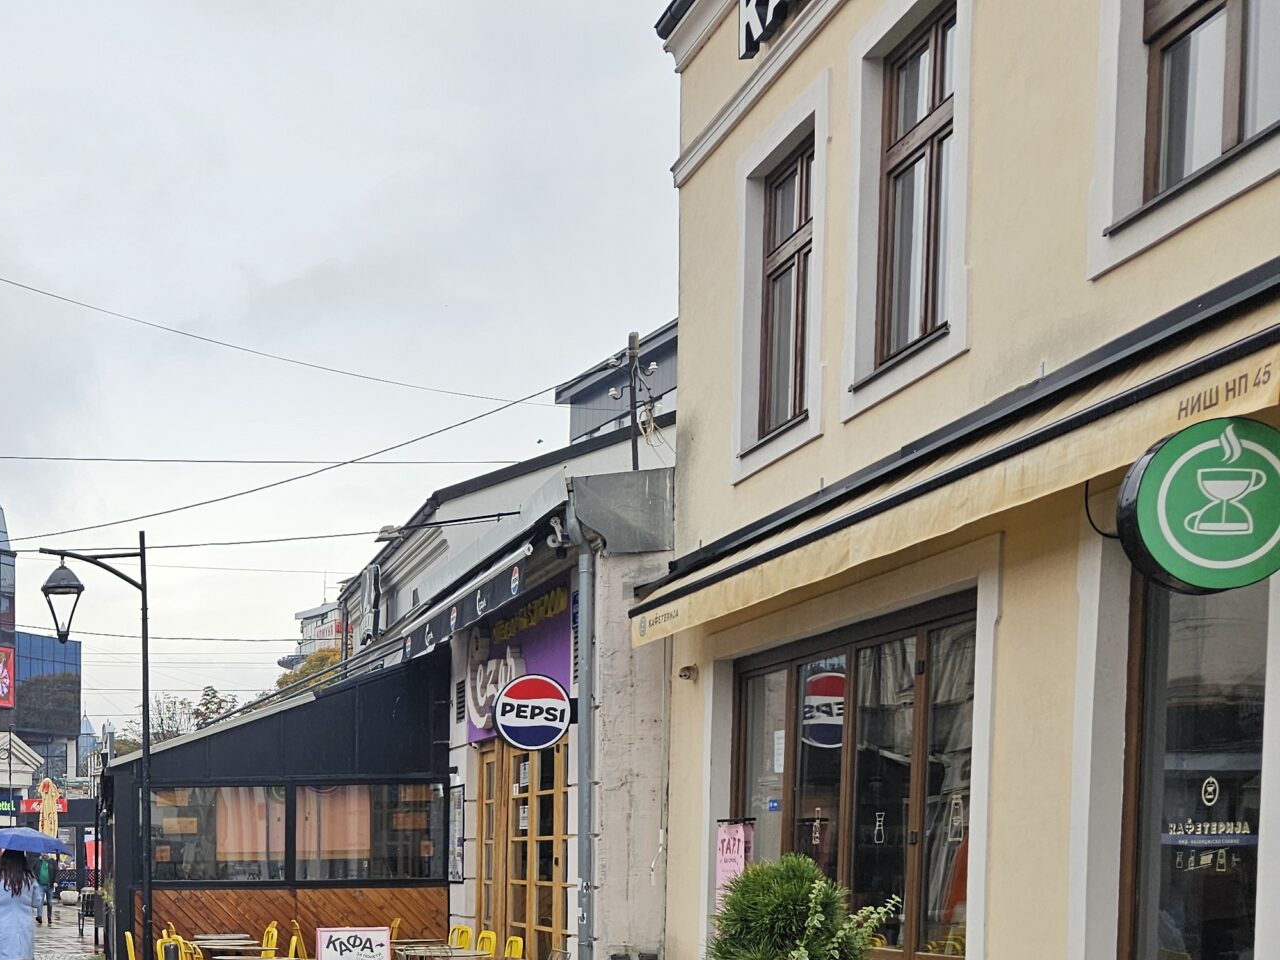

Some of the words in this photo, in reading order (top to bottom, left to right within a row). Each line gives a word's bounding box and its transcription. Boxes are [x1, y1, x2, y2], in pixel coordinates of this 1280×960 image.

[1177, 385, 1219, 420] НИШ
[1225, 373, 1248, 402] НП
[1253, 362, 1272, 388] 45
[500, 701, 566, 723] PEPSI
[326, 934, 374, 956] КАФА
